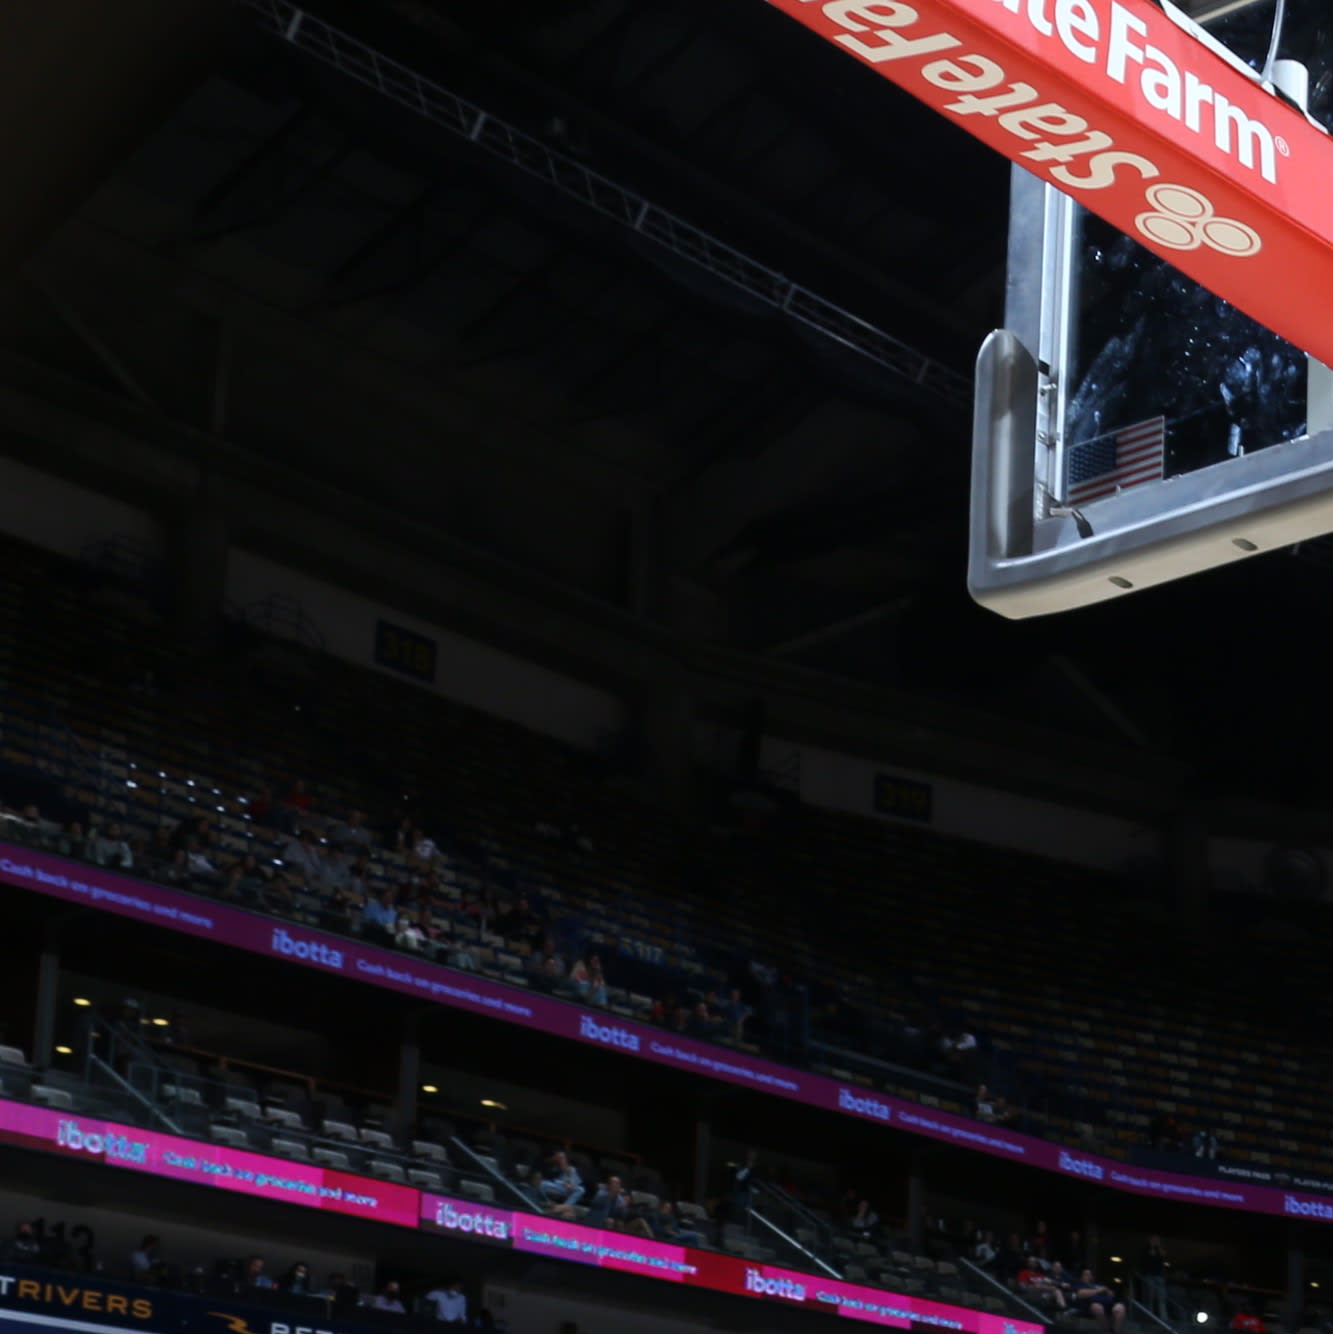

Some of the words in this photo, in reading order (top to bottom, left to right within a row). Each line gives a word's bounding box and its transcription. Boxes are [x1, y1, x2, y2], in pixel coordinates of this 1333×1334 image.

[271, 928, 343, 969] ibotta
[579, 1015, 641, 1051] ibotta
[838, 1087, 891, 1120] ibotta
[56, 1119, 148, 1163] ibotta
[435, 1202, 509, 1241] ibotta
[745, 1269, 806, 1301] ibotta
